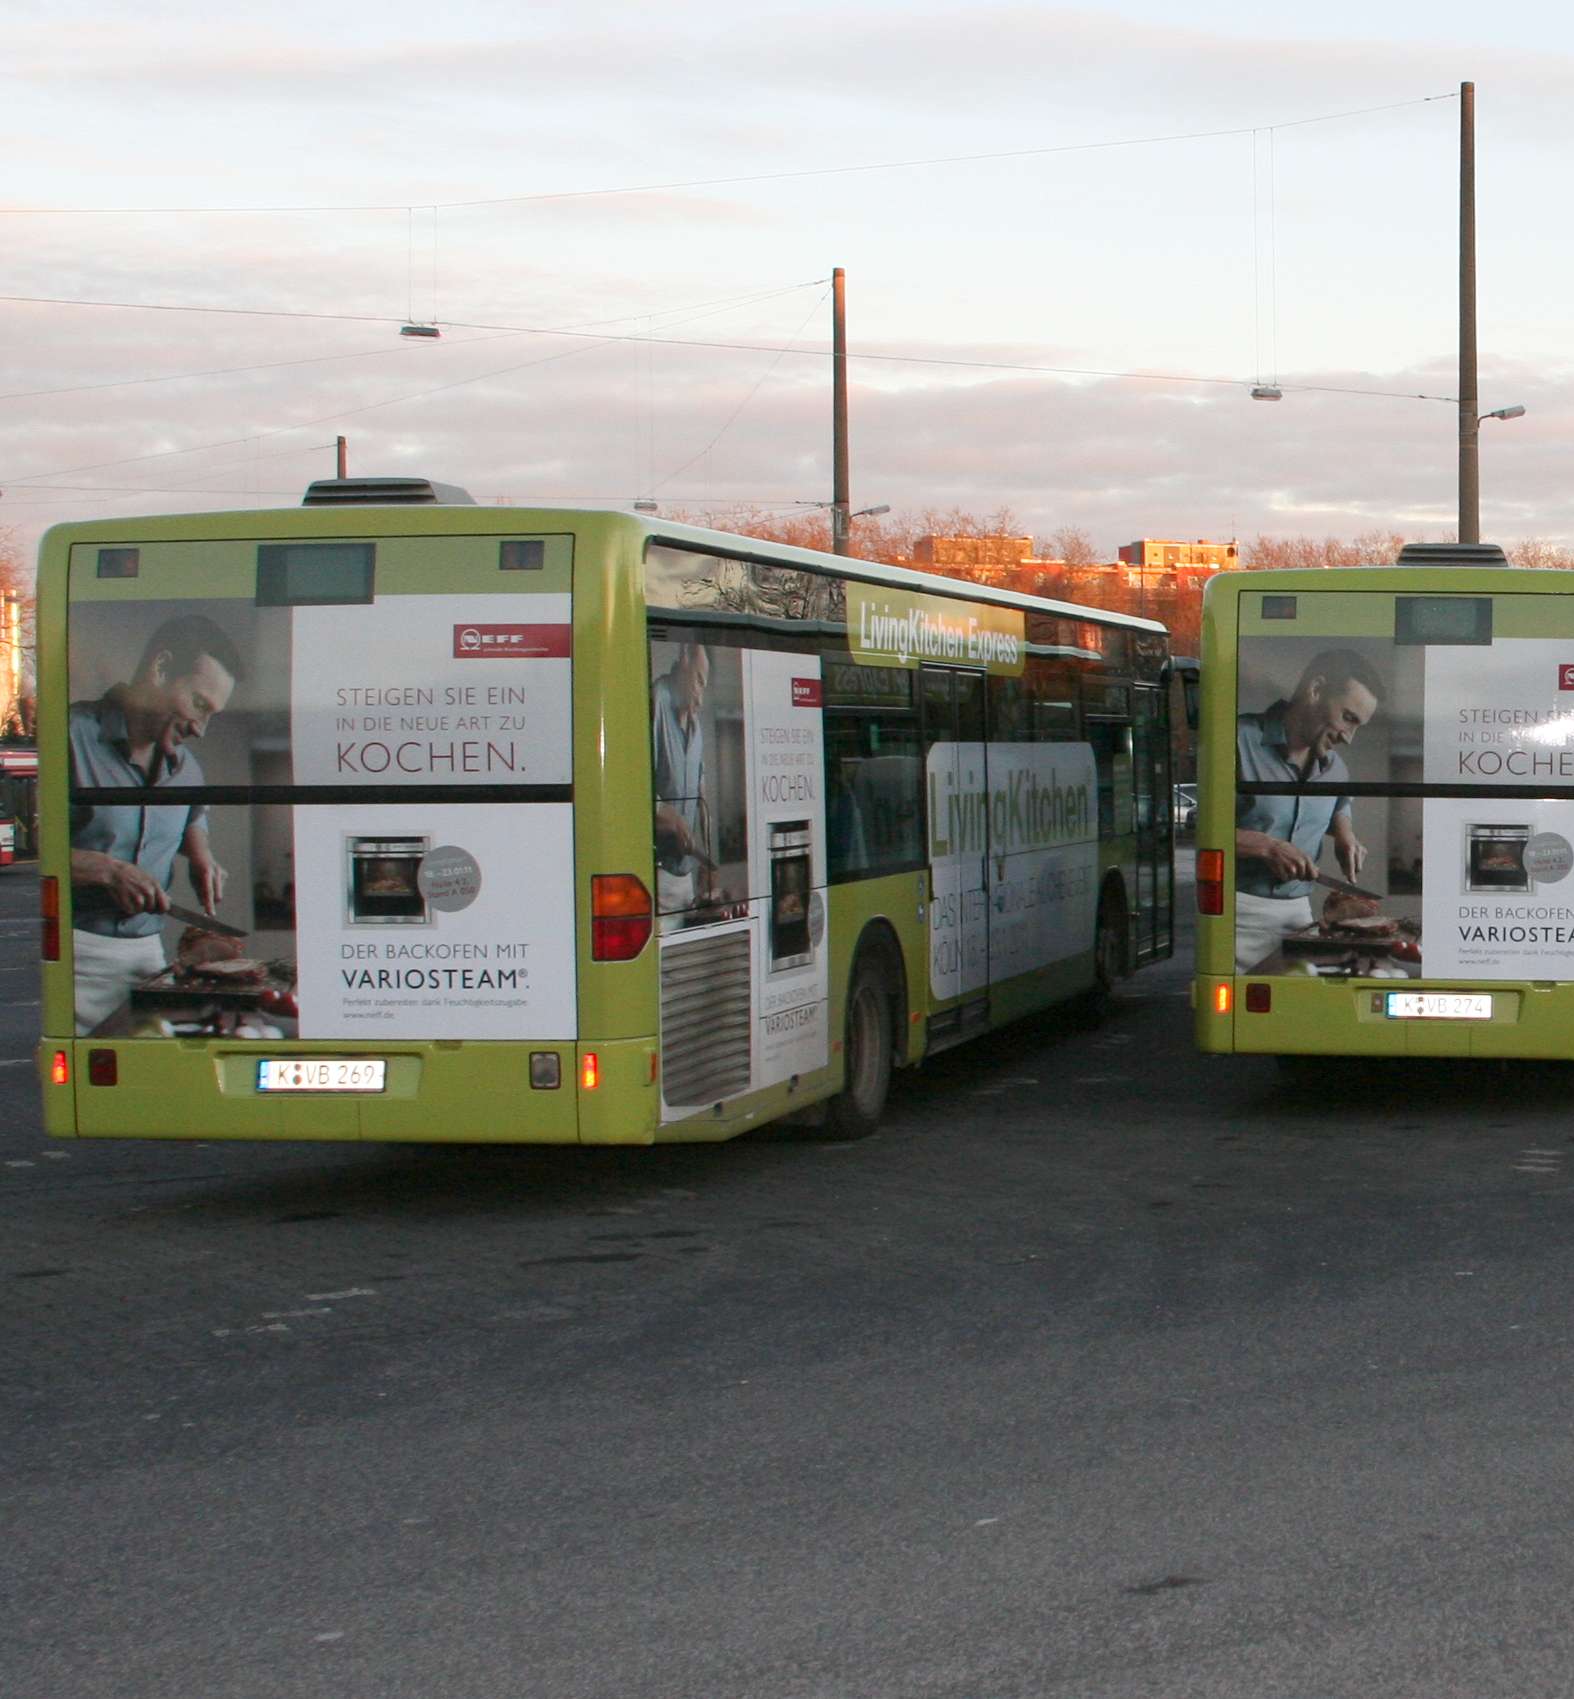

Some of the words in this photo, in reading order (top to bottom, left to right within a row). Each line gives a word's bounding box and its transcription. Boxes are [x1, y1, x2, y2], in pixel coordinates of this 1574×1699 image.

[860, 600, 963, 664] LivingKitchen
[968, 617, 1018, 665] Express
[336, 687, 433, 706] STEIGEN
[445, 687, 476, 705] SIE
[487, 687, 525, 705] EIN
[336, 717, 355, 731] IN
[363, 717, 392, 731] DIE
[400, 717, 449, 731] NEUE
[455, 716, 491, 731] ART
[499, 716, 526, 730] ZU
[1459, 709, 1538, 724] STEIGEN
[1459, 732, 1474, 743] IN
[1480, 732, 1503, 743] DIE
[337, 741, 526, 773] KOCHEN.
[929, 768, 1090, 880] LivingKitchen
[1458, 906, 1489, 919] DER
[341, 944, 377, 960] DER
[386, 944, 488, 960] BACKOFEN
[496, 943, 529, 959] MIT
[1404, 998, 1413, 1013] K
[1427, 998, 1448, 1013] VB
[1454, 998, 1483, 1014] 274
[278, 1064, 289, 1085] K
[306, 1064, 330, 1085] VB
[337, 1064, 375, 1085] 269
